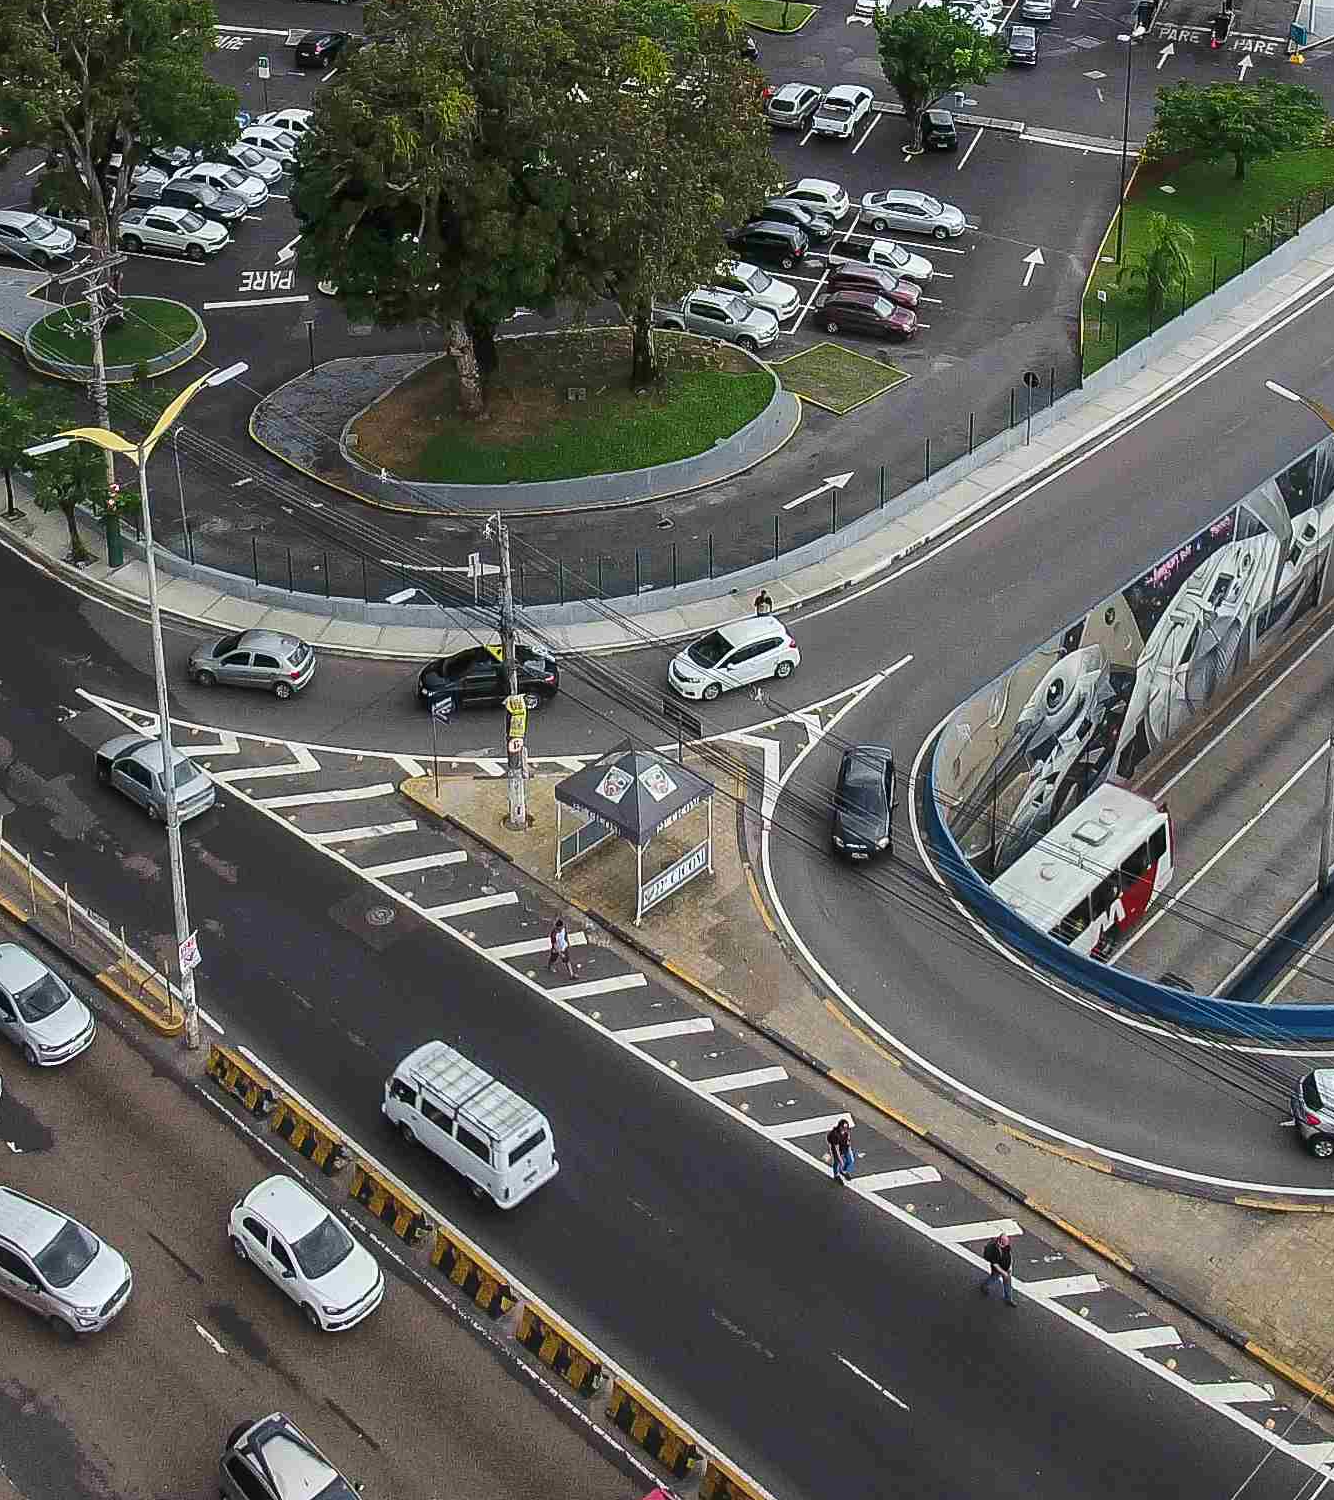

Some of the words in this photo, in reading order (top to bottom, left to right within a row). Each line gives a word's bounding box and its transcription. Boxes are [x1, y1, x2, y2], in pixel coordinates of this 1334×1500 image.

[1158, 27, 1200, 43] PARE
[1233, 38, 1278, 55] PARE
[238, 269, 293, 291] PARE
